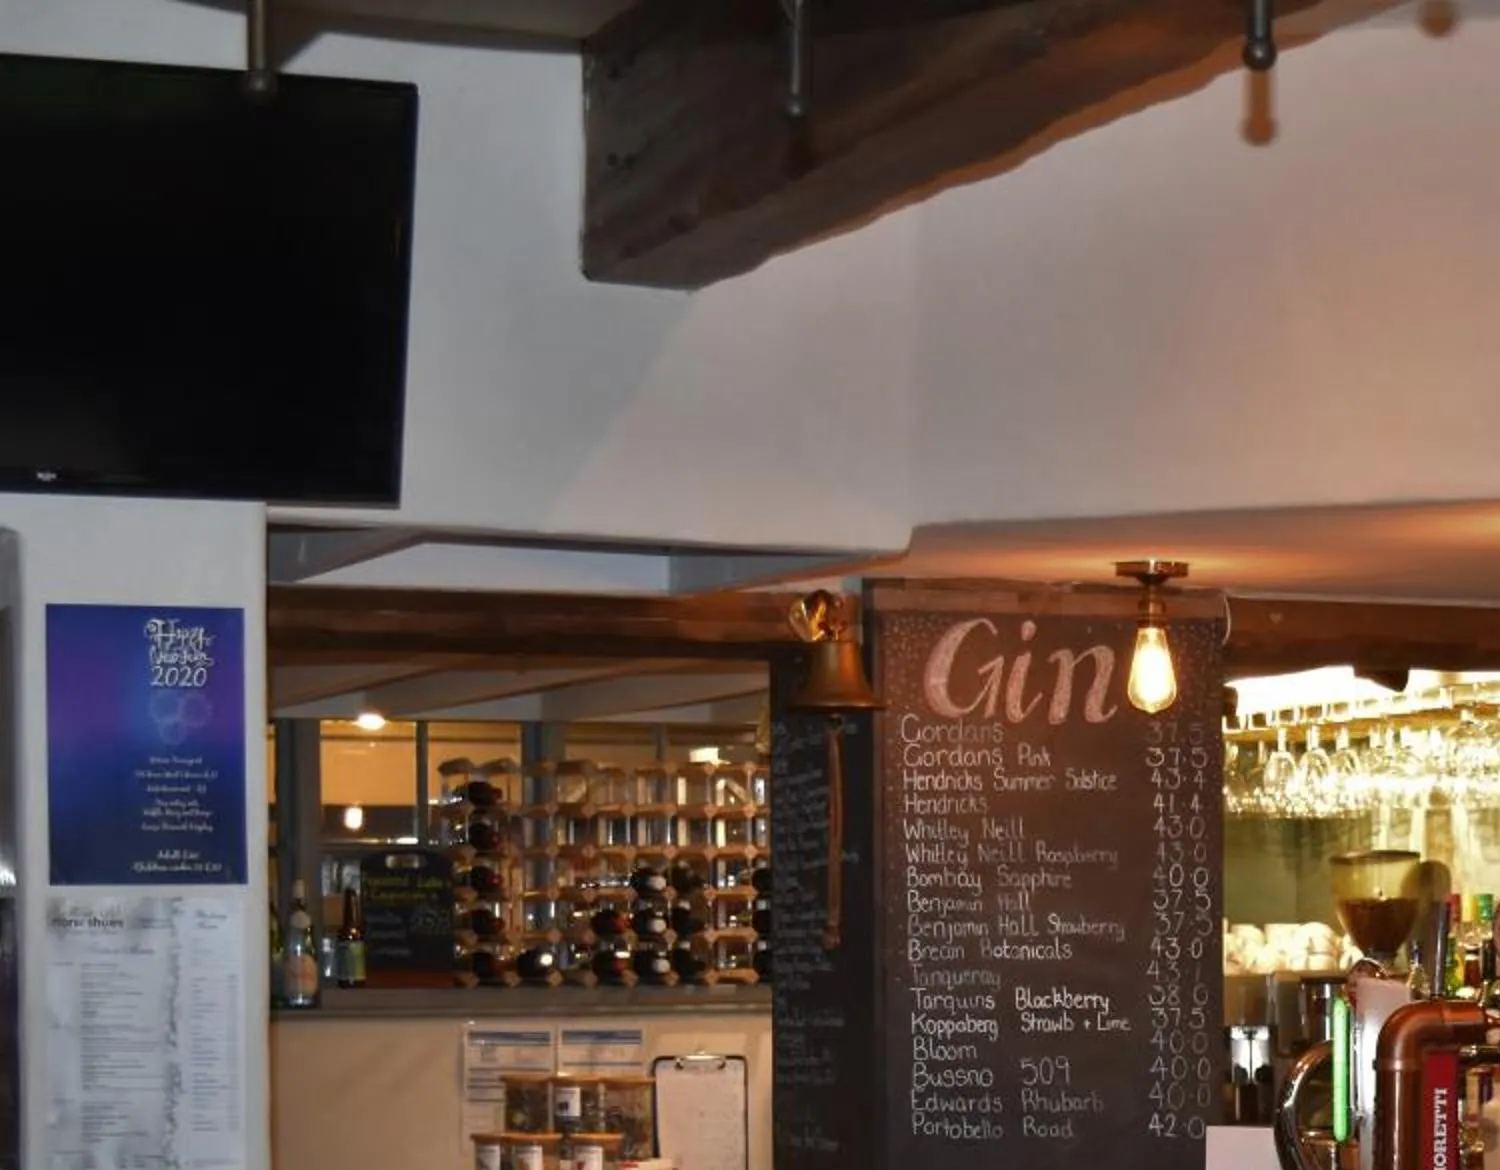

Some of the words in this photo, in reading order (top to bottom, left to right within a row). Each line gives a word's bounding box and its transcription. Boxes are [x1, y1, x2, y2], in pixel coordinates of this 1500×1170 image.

[150, 666, 207, 687] 2020
[924, 618, 1118, 724] Gin
[1017, 743, 1051, 767] Pink
[903, 769, 983, 791] Hendricks
[993, 768, 1055, 792] Summer
[904, 794, 989, 815] Hendricks
[904, 818, 970, 848] Whitley
[981, 817, 1025, 840] Neill
[905, 841, 968, 869] Whitley
[978, 843, 1024, 863] Neill
[1036, 840, 1118, 871] Raspberry
[906, 866, 983, 896] Bombay
[997, 864, 1073, 894] Sapphire
[907, 890, 983, 917] Benjamin
[998, 891, 1031, 911] Hall
[907, 914, 989, 944] Benjamin
[999, 913, 1039, 937] Hall
[1047, 913, 1125, 942] Strawberry
[981, 936, 1073, 960] Botanicals
[912, 963, 1001, 991] Tanqueray
[909, 987, 995, 1015] Tarquins
[1015, 986, 1110, 1014] Blackberry
[1021, 1011, 1075, 1033] Strawb
[1097, 1012, 1132, 1031] Lime
[913, 1035, 977, 1061] Bloom
[1020, 1055, 1070, 1085] 509
[911, 1089, 1002, 1113] Edwards
[1021, 1088, 1102, 1113] Rhubarb
[912, 1112, 1003, 1140] Portobello
[1023, 1115, 1073, 1138] Road
